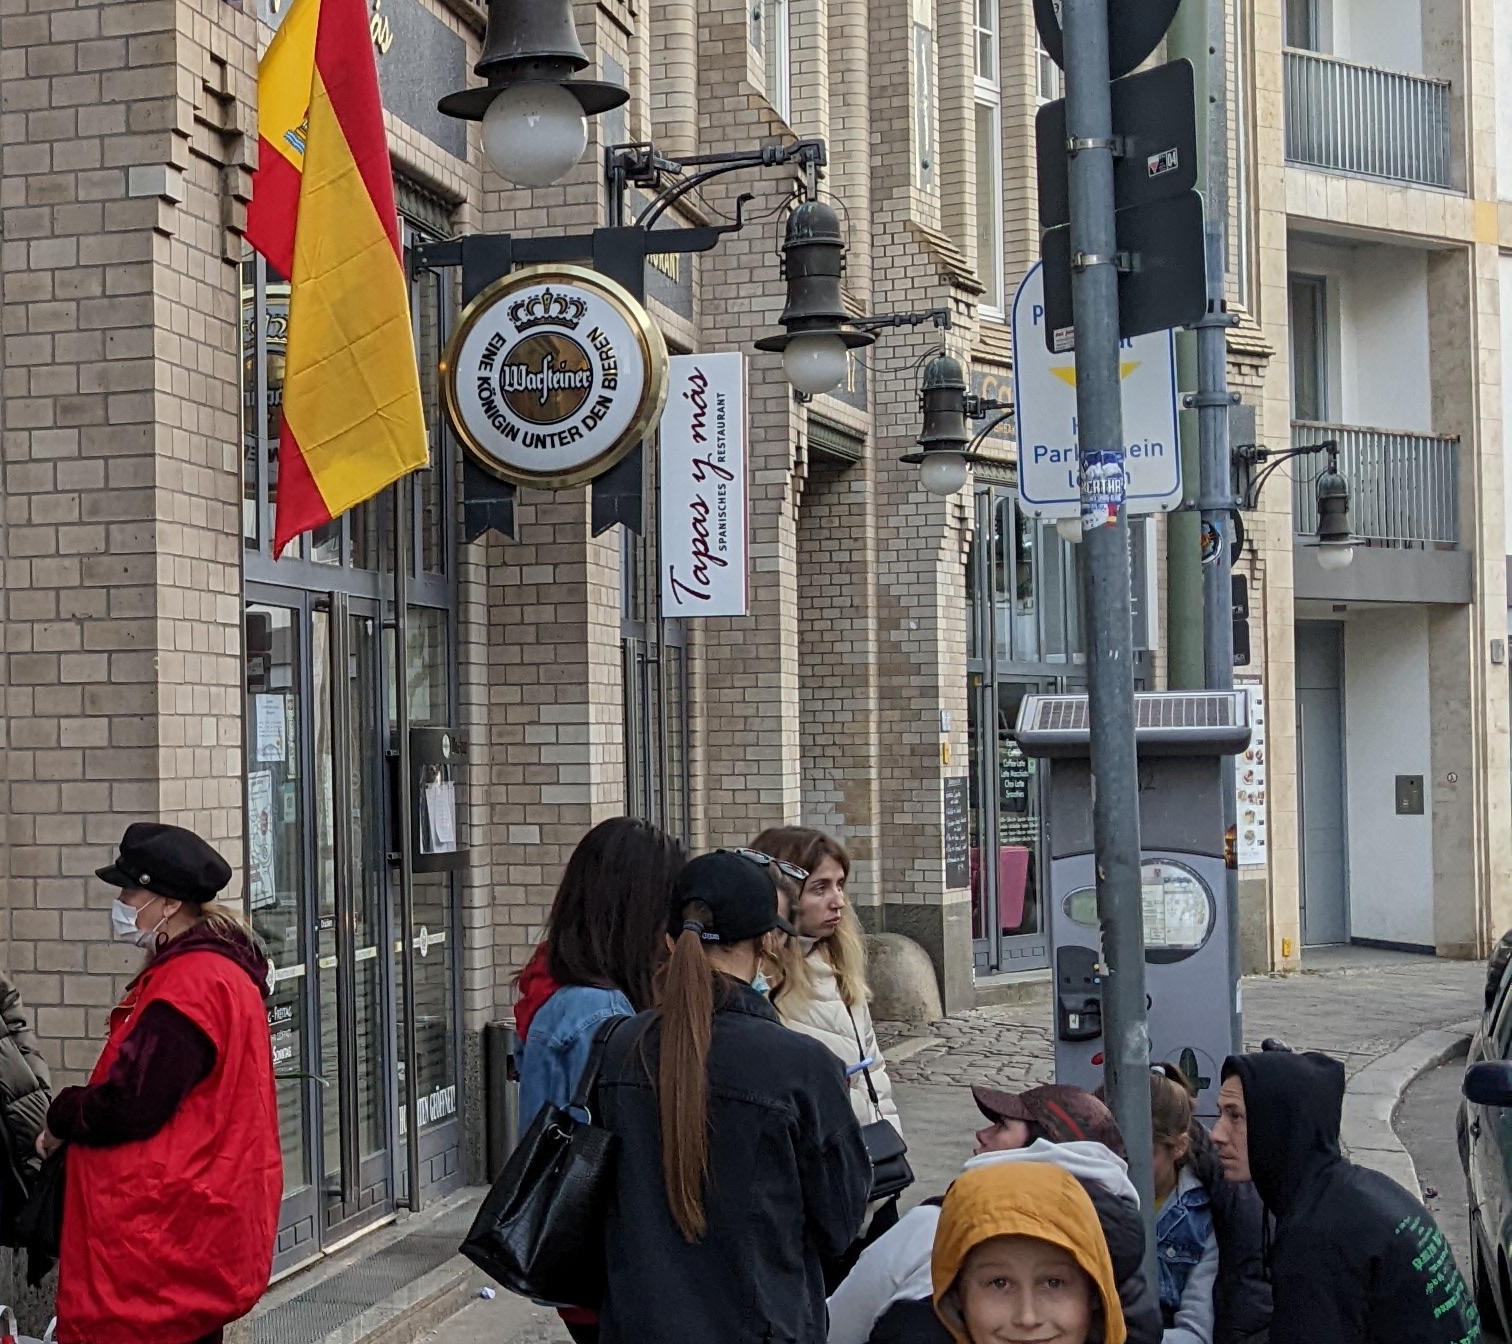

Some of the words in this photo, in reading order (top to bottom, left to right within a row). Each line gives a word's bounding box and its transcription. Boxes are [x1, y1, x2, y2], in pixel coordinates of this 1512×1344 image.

[478, 332, 507, 373] EINE
[586, 326, 619, 392] BIEREN
[476, 376, 521, 442] KÖNIGIN
[522, 425, 584, 450] UNTER
[581, 394, 613, 432] DEN
[682, 366, 709, 444] más
[716, 392, 726, 463] RESTAURANT
[691, 452, 735, 484] y
[669, 493, 729, 605] Tapas
[717, 483, 727, 552] SPANISCHES
